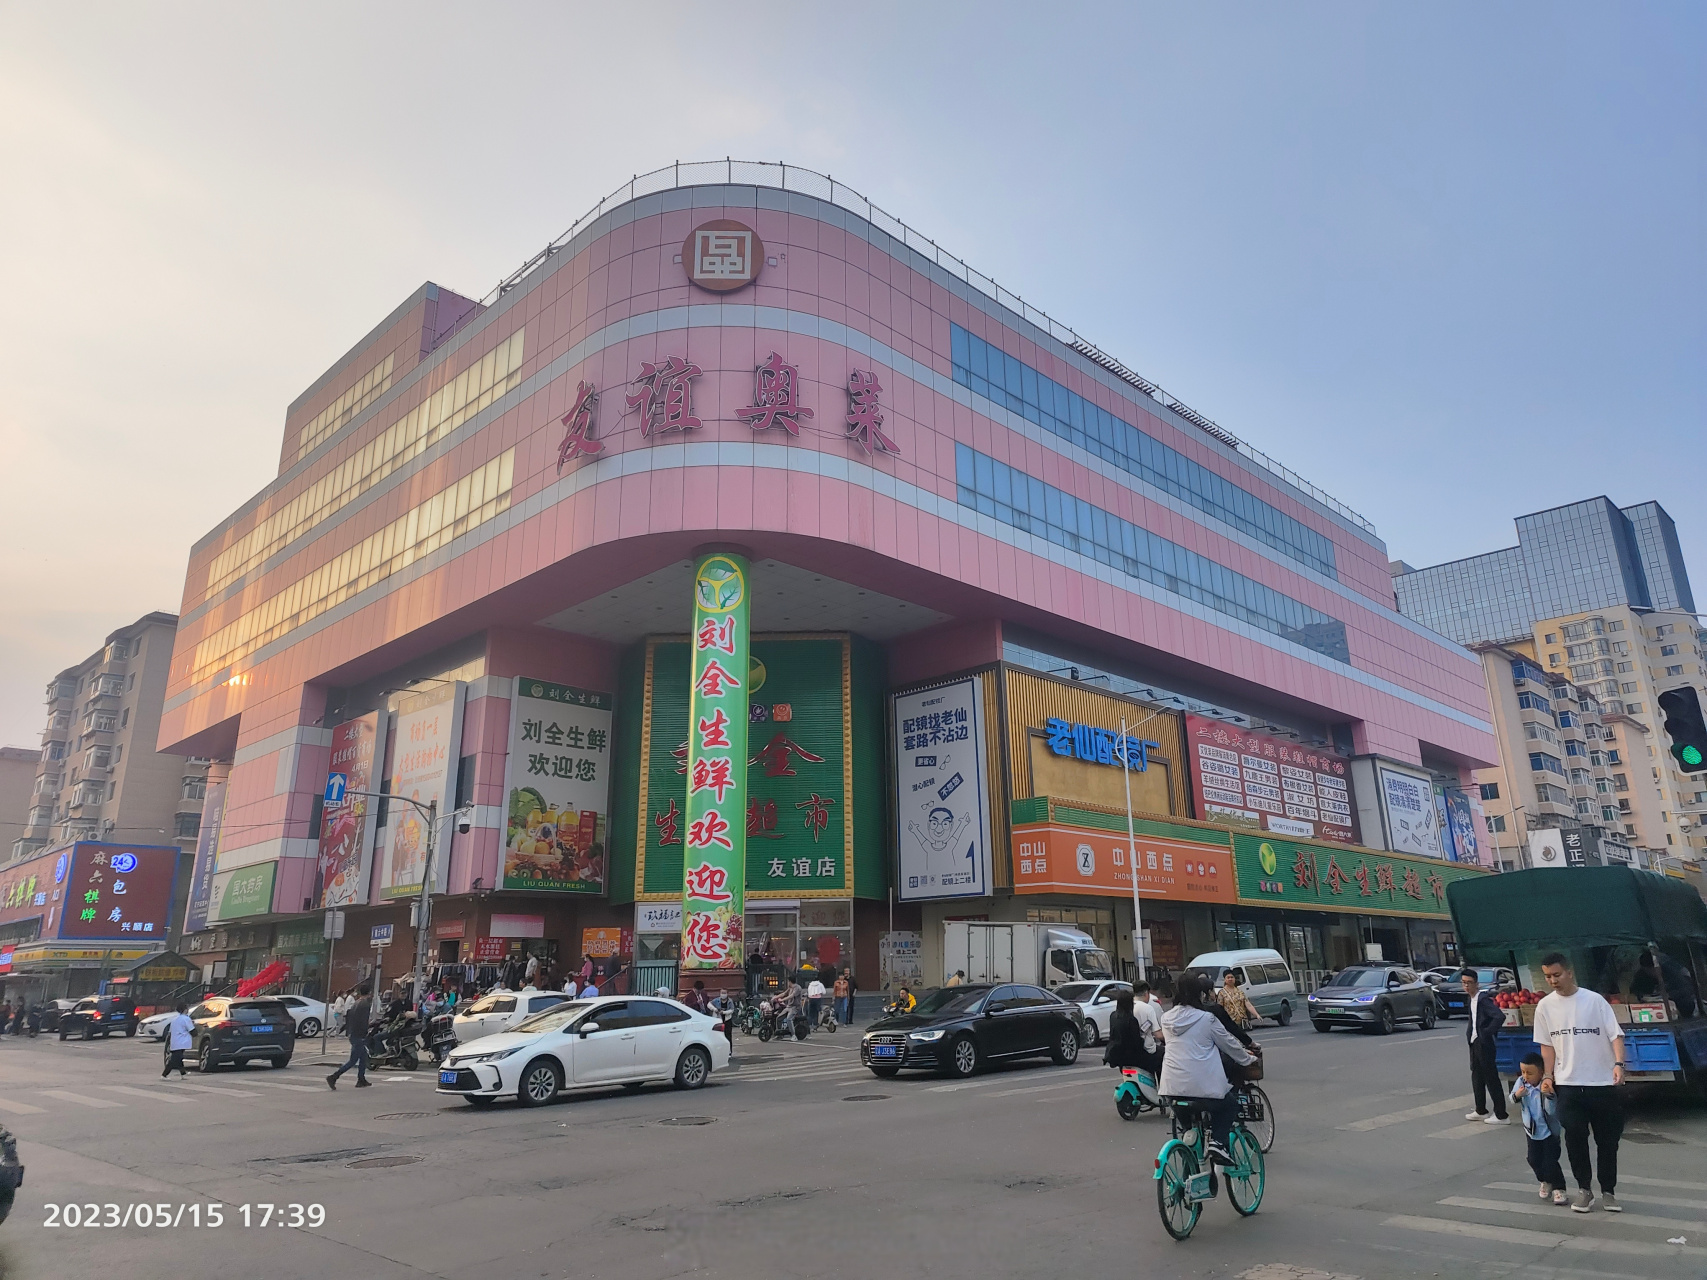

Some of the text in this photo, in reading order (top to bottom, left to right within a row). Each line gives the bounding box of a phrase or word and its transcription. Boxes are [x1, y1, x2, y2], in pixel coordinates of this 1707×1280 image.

[557, 351, 901, 475] 友谊奥莱
[549, 689, 600, 706] 刘全生鲜
[902, 707, 967, 734] 配镜找老仙
[521, 719, 607, 752] 刘全生鲜
[904, 725, 968, 750] 套路不沾边
[1046, 717, 1160, 772] 老仙配镜厂
[527, 753, 597, 782] 欢迎您
[685, 615, 740, 963] 刘全生鲜欢迎您
[655, 793, 836, 848] 生超市
[1019, 841, 1046, 857] 中山
[1112, 848, 1174, 872] 中山西点
[1566, 833, 1585, 867] 老正
[767, 856, 836, 877] 友谊店
[1020, 859, 1047, 874] 西点
[1161, 876, 1175, 884] DIAN
[1292, 850, 1445, 907] 刘全生鲜超市
[538, 881, 560, 889] QUAN
